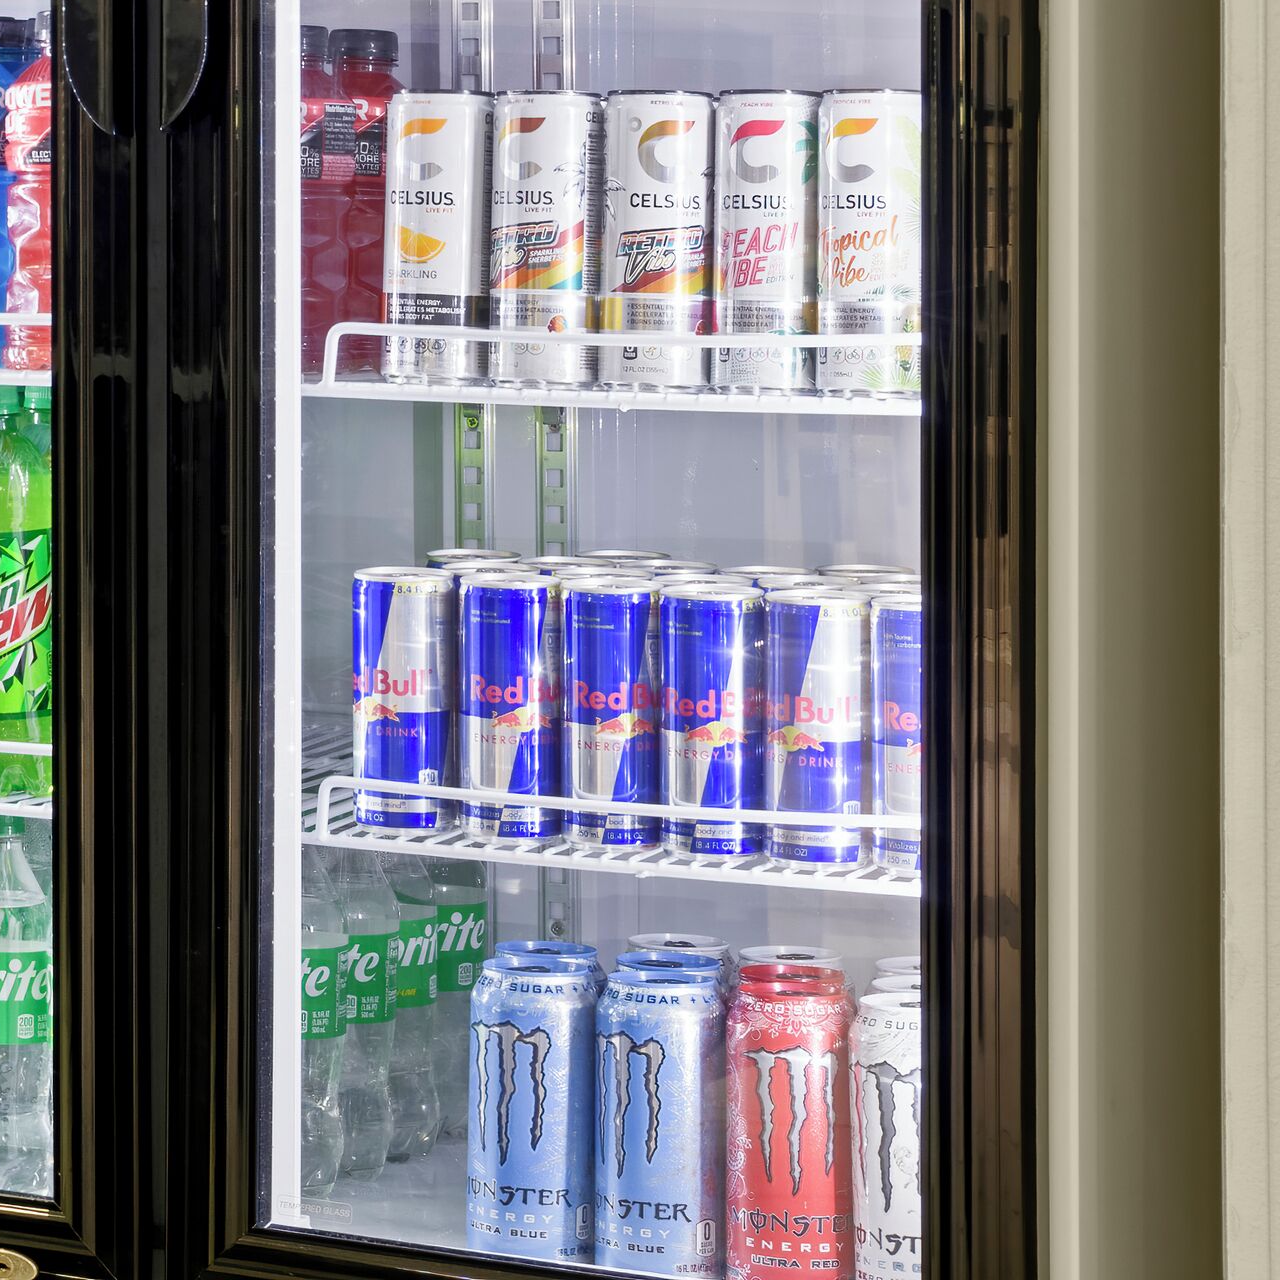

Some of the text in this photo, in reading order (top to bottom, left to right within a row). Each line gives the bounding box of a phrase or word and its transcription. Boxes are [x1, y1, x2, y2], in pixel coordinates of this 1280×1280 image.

[391, 190, 453, 206] CELSIUS
[494, 190, 553, 206] CELSIUS
[630, 193, 700, 209] CELSIUS
[823, 194, 886, 210] CELSIUS
[820, 215, 899, 262] Tropical
[388, 270, 437, 279] SARKLING
[630, 303, 664, 311] ESSENTIAL
[847, 306, 874, 314] ENERGY
[397, 584, 412, 594] 8.4
[374, 668, 426, 697] Bull
[470, 673, 524, 705] Red
[574, 680, 628, 711] Red
[665, 687, 716, 719] Red
[376, 727, 419, 738] DRINK
[474, 734, 525, 746] ENERGY
[578, 739, 631, 752] ENERGY
[668, 748, 720, 761] ENERGY
[799, 755, 844, 769] DRINK
[846, 803, 859, 814] 110
[606, 831, 622, 841] (8.4
[696, 827, 716, 838] body
[790, 833, 825, 844] and mind
[695, 840, 710, 850] (8.4
[888, 840, 918, 852] Vitalizes
[900, 856, 912, 865] mL
[459, 966, 472, 975] 200
[508, 981, 565, 995] SUGAR
[624, 991, 680, 1006] SUGAR
[747, 999, 842, 1017] ZERO SUGAR
[18, 1016, 34, 1027] 200
[323, 1206, 351, 1218] GLASS
[468, 1202, 554, 1225] ENERGY
[471, 1220, 548, 1240] ULTRA BLUE
[627, 1242, 666, 1255] BLUE
[745, 1236, 844, 1254] ENERGY
[751, 1254, 840, 1269] ULTRA RED
